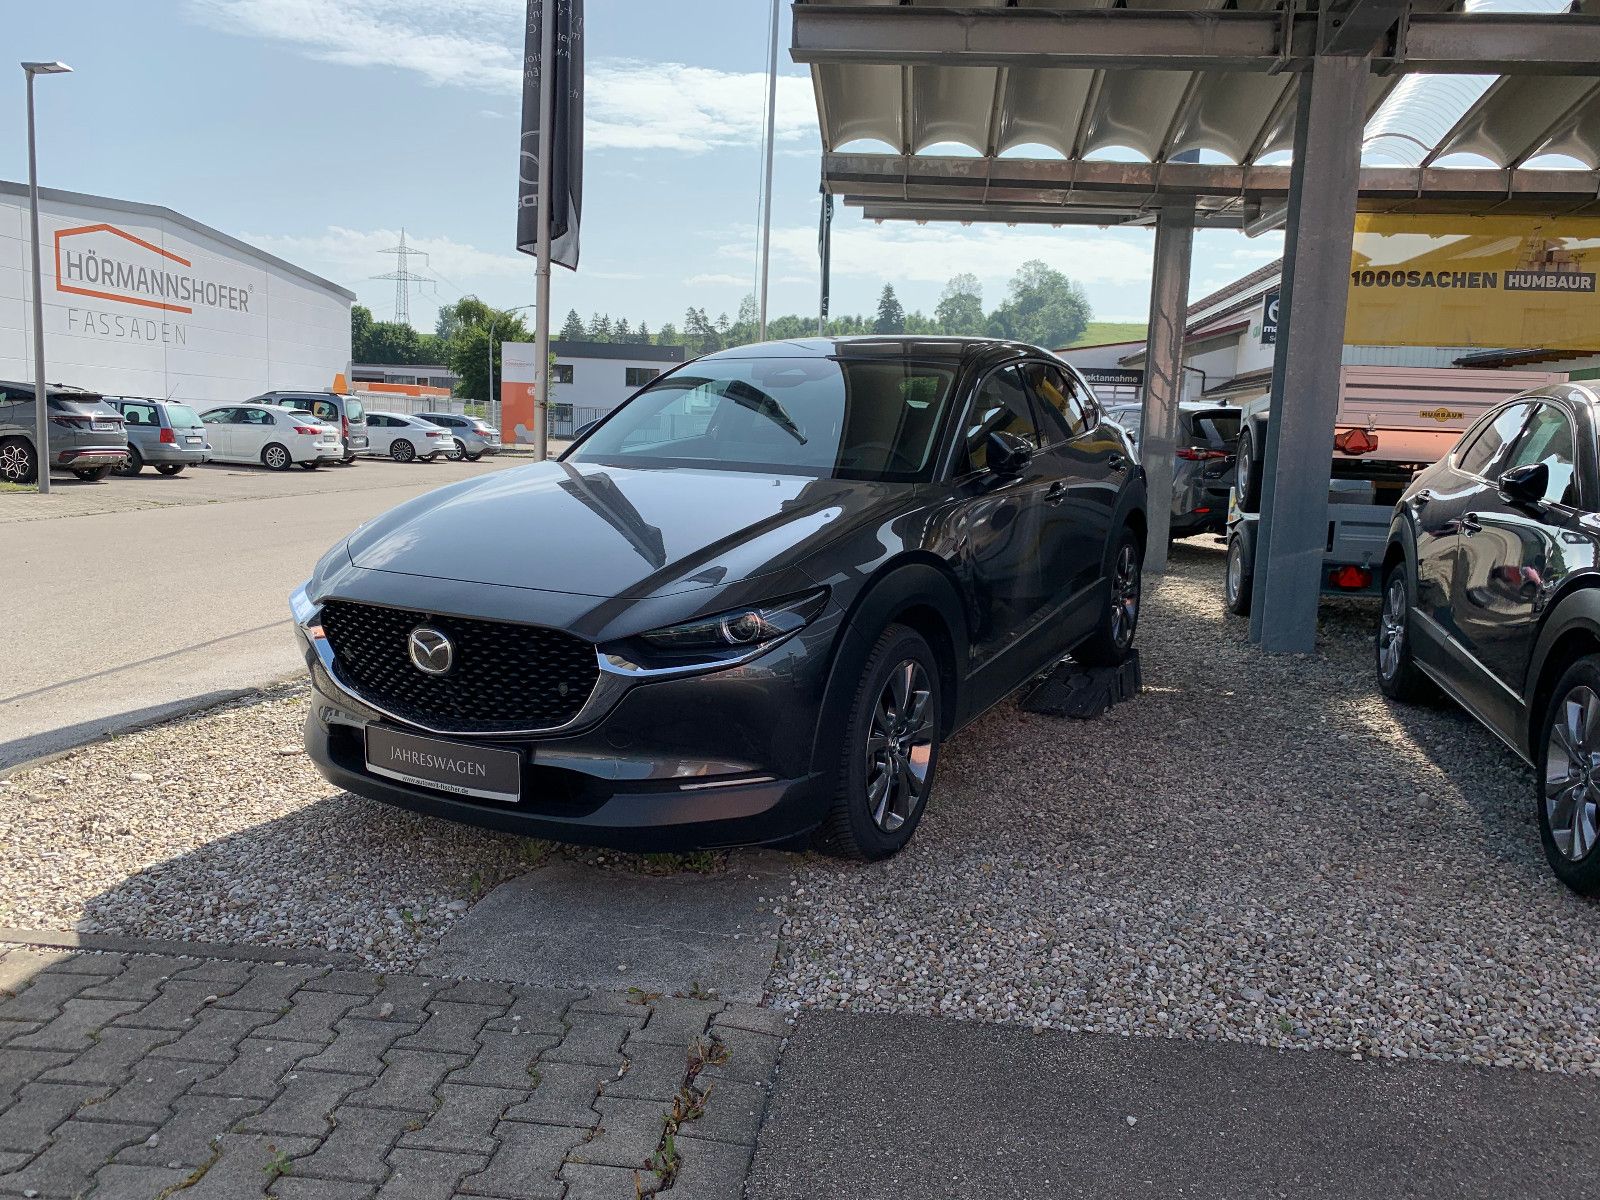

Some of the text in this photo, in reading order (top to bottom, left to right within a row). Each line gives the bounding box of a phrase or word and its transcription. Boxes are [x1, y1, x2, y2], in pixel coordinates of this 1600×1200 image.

[1351, 270, 1592, 290] 1000SACHEN HUMBAUR
[68, 308, 187, 345] FASSADEN
[390, 746, 486, 777] JAHRESWAGEN
